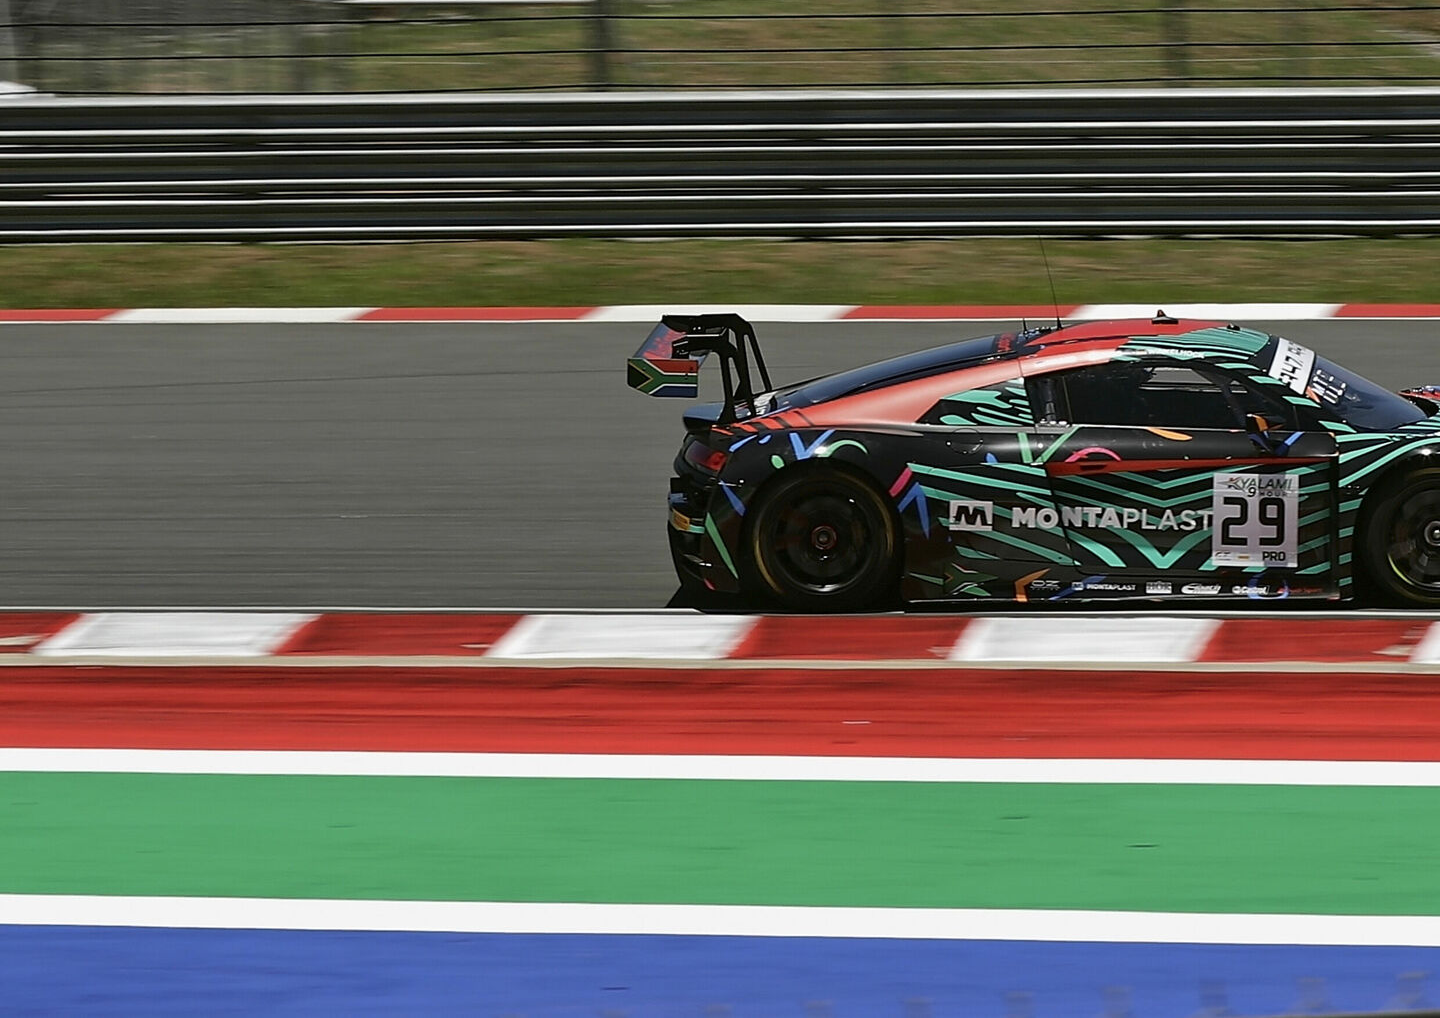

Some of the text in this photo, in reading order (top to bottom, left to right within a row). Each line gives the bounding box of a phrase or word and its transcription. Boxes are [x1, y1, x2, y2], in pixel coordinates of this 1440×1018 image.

[1012, 506, 1214, 531] MONTAPLAST
[1221, 496, 1286, 546] 29
[1262, 551, 1287, 562] PRO
[1086, 583, 1137, 591] MONTAPLAST
